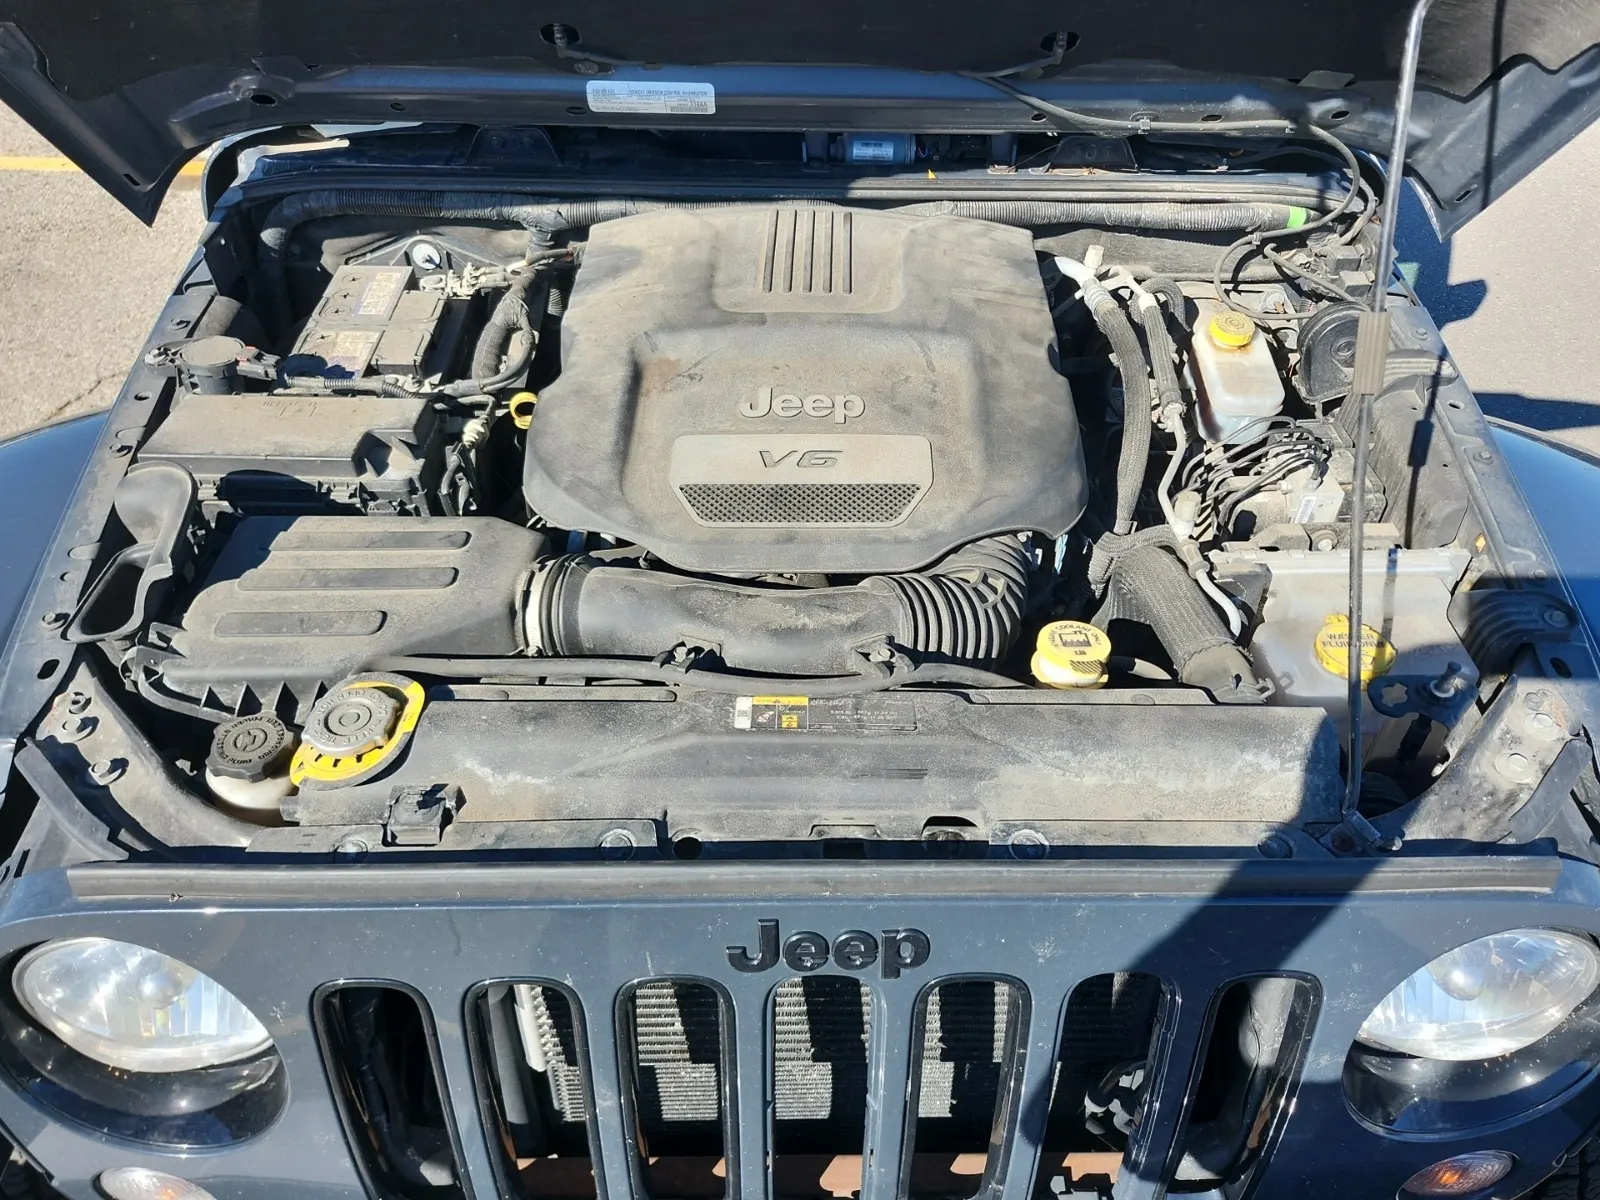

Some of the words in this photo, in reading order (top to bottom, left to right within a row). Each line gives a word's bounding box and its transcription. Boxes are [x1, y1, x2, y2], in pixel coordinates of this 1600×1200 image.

[739, 387, 866, 424] Jeep
[759, 450, 843, 468] V6
[725, 918, 931, 979] Jeep
